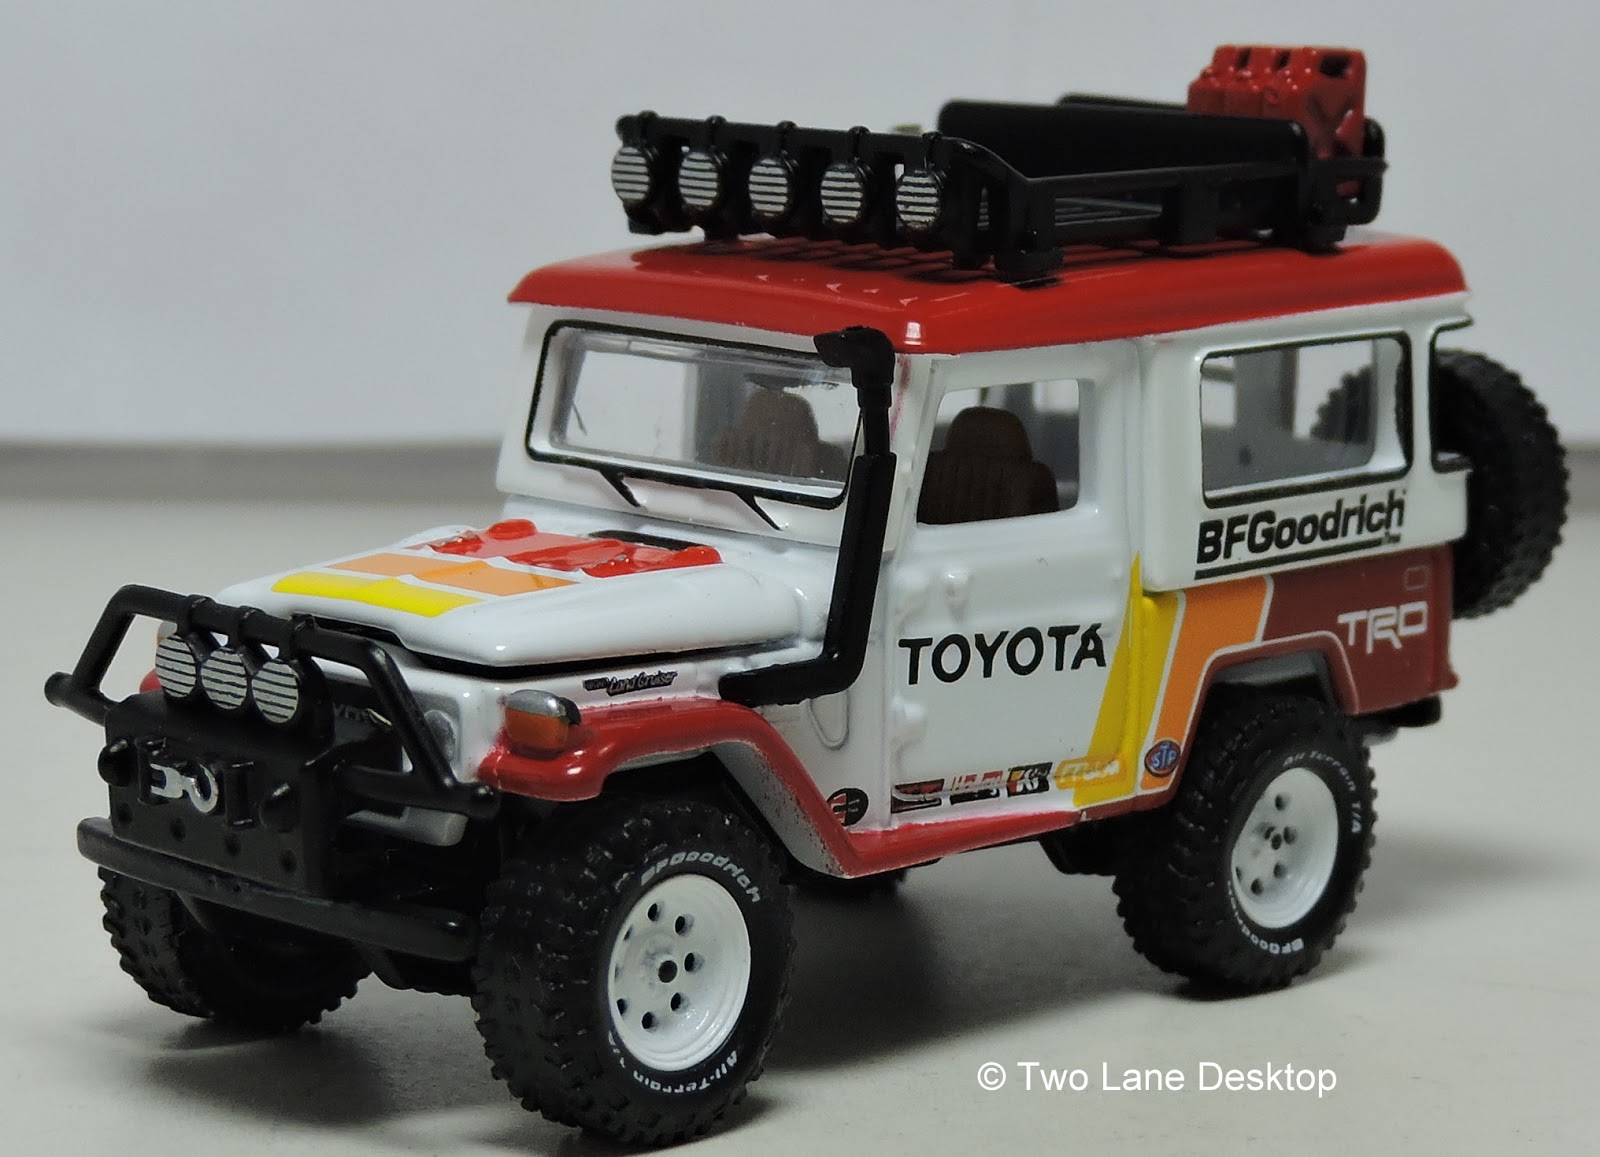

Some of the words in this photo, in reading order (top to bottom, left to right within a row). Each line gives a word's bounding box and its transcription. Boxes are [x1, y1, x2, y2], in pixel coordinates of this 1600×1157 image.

[1196, 488, 1406, 565] BFGoodrich
[898, 622, 1107, 686] TOYOTA
[1337, 600, 1429, 655] TRD
[1151, 744, 1177, 769] STP
